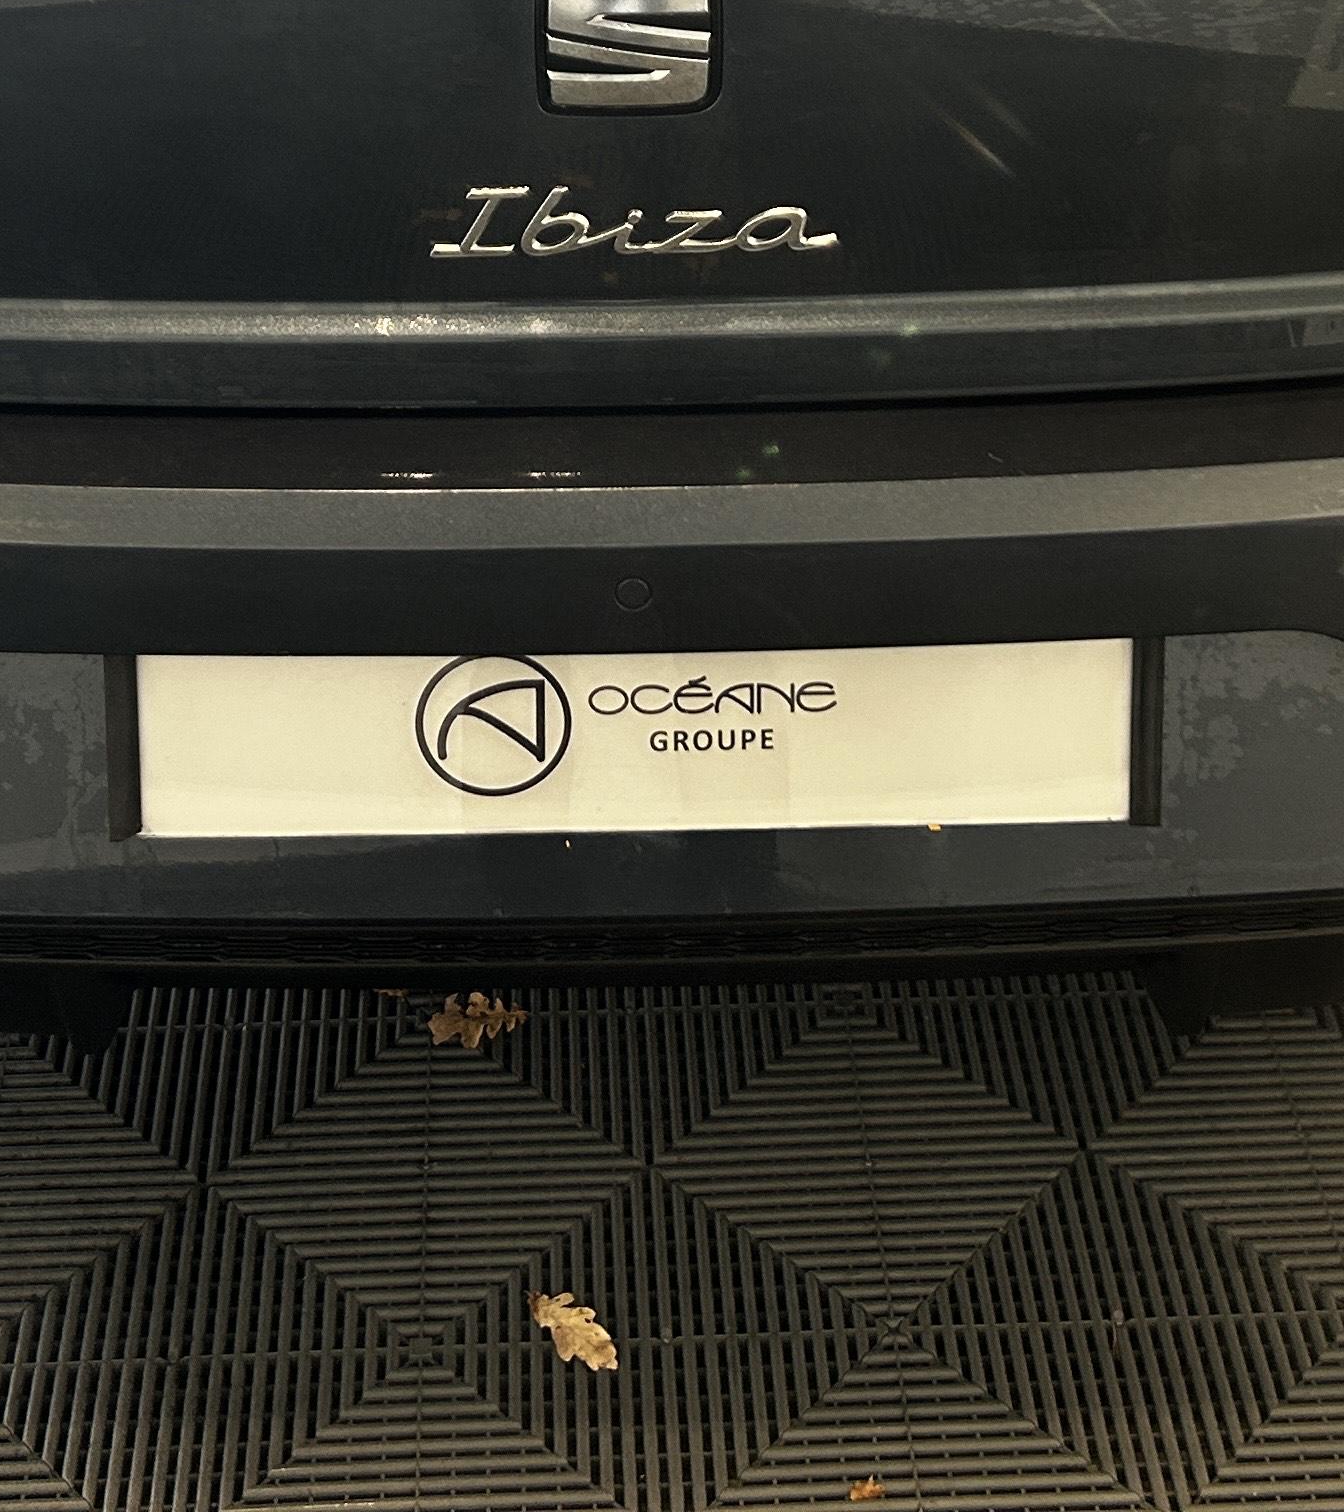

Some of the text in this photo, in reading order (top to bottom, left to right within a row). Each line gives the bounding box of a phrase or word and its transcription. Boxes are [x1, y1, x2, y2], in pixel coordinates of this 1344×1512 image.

[429, 184, 841, 258] Ibiza
[587, 675, 838, 716] OCÉANE
[648, 727, 776, 753] GROUPE
